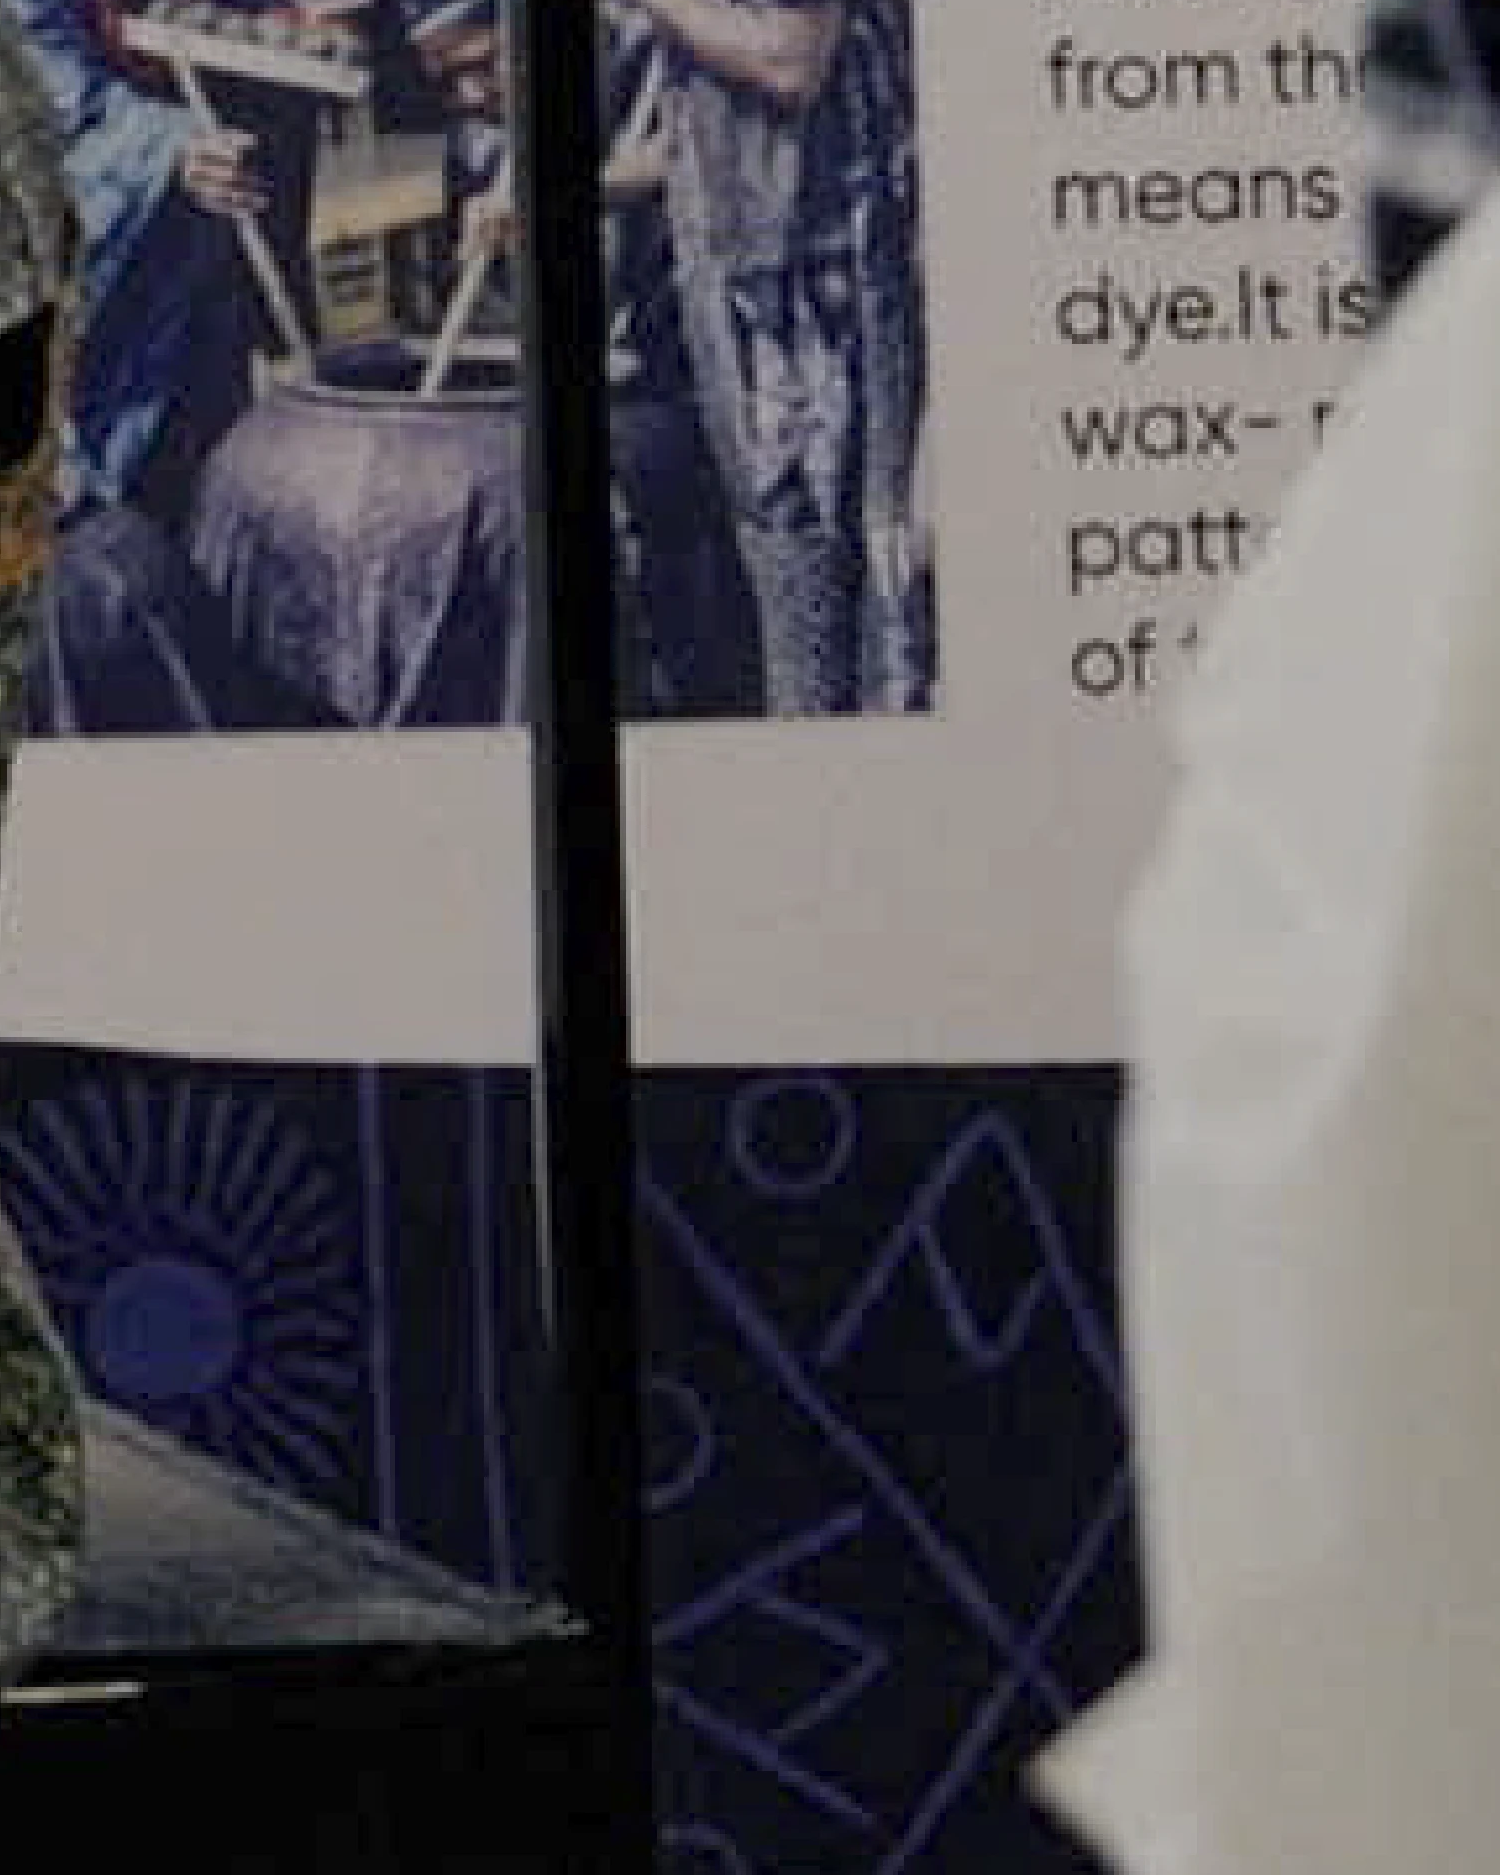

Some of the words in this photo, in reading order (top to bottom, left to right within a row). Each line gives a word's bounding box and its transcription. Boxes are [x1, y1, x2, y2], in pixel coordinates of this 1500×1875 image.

[1047, 39, 1240, 106] from
[1267, 35, 1365, 104] th
[1053, 168, 1341, 227] means
[1071, 509, 1253, 596] patt
[1071, 619, 1156, 695] of
